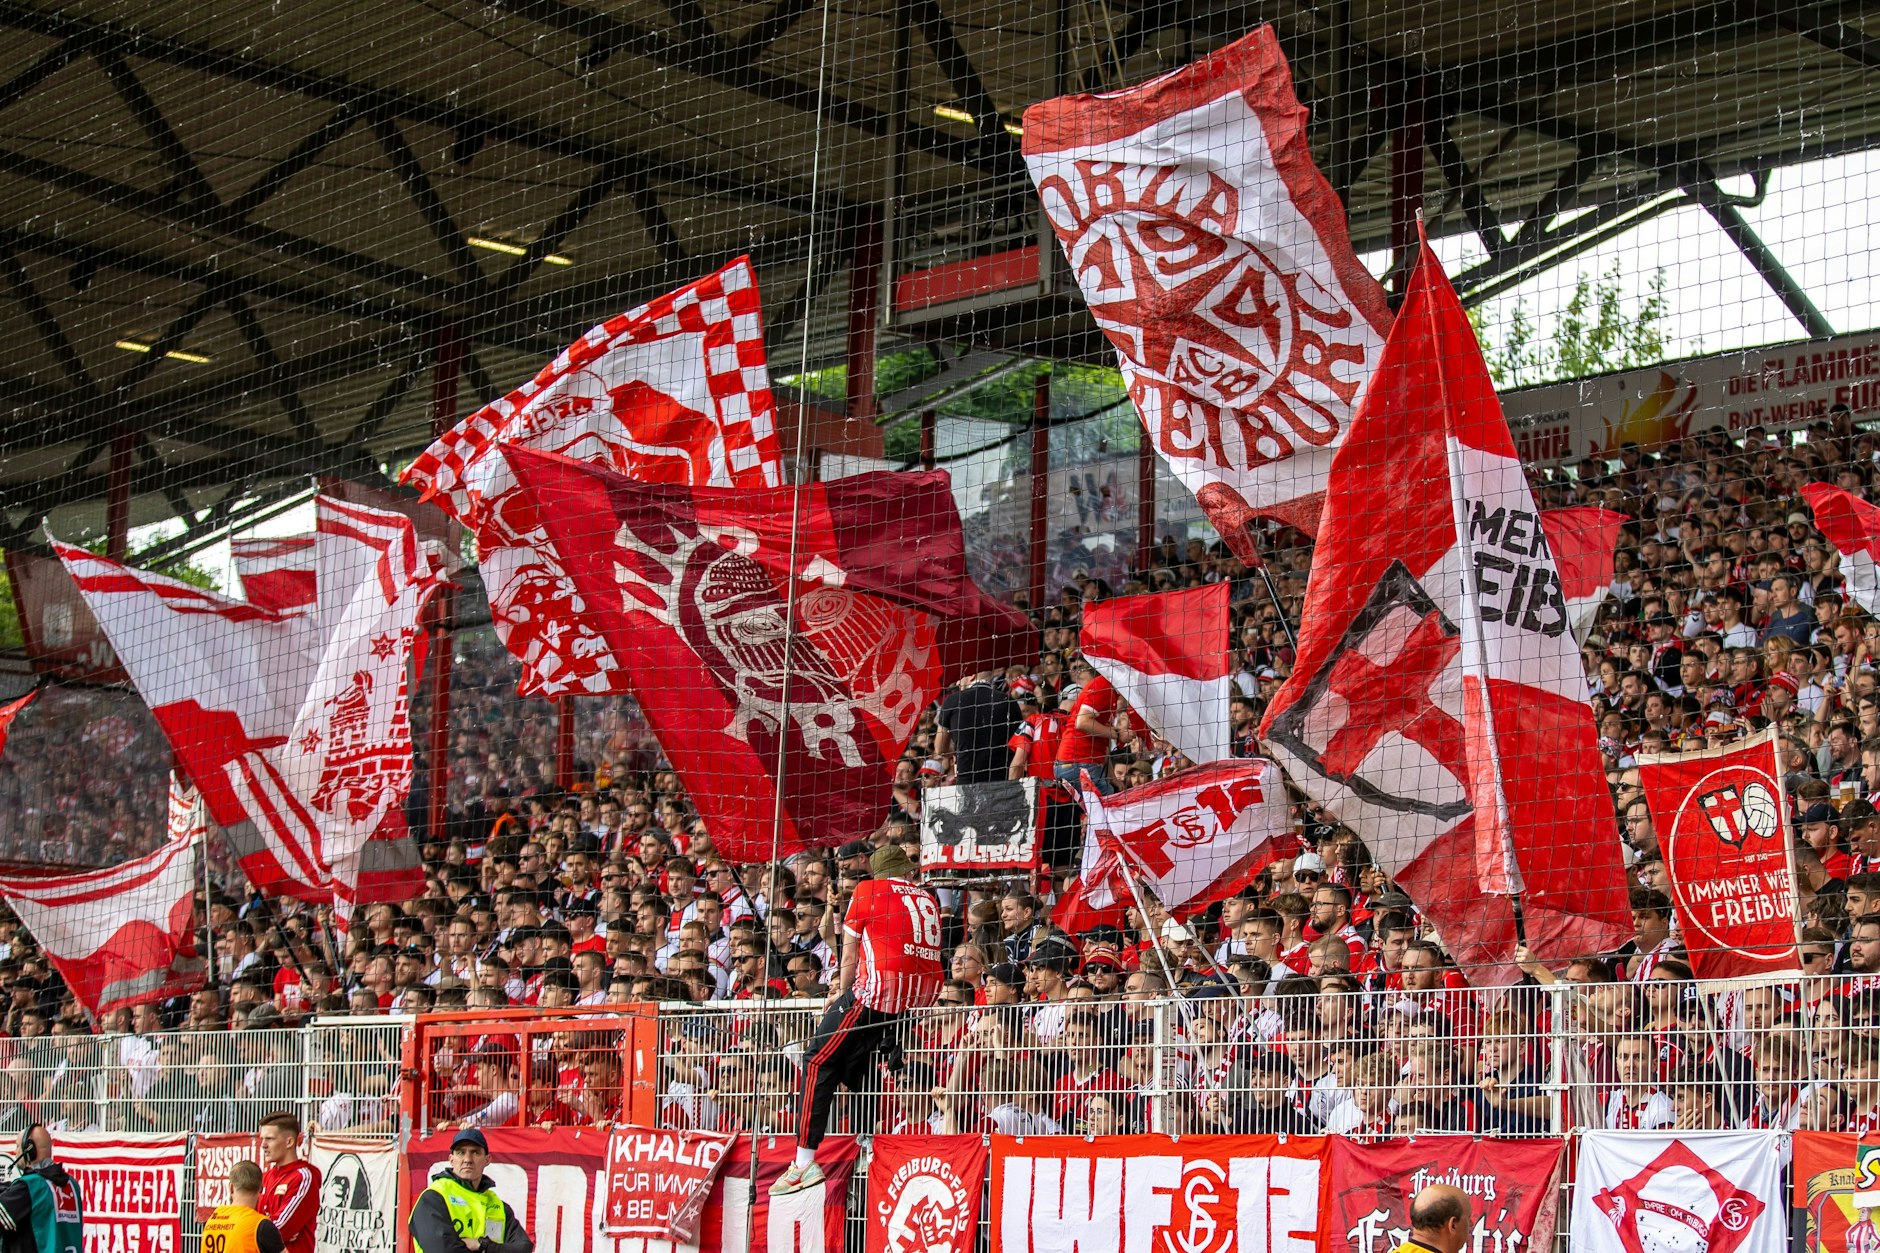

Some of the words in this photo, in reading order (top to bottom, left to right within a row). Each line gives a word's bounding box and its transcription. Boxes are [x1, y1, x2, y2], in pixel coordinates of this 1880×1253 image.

[1466, 499, 1550, 560] MER
[901, 895, 942, 947] 18
[904, 943, 915, 955] SC
[615, 1133, 725, 1170] KHALID
[613, 1167, 650, 1193] FÜR
[627, 1199, 653, 1219] BEI
[147, 1224, 174, 1253] 79
[205, 1233, 226, 1253] 90
